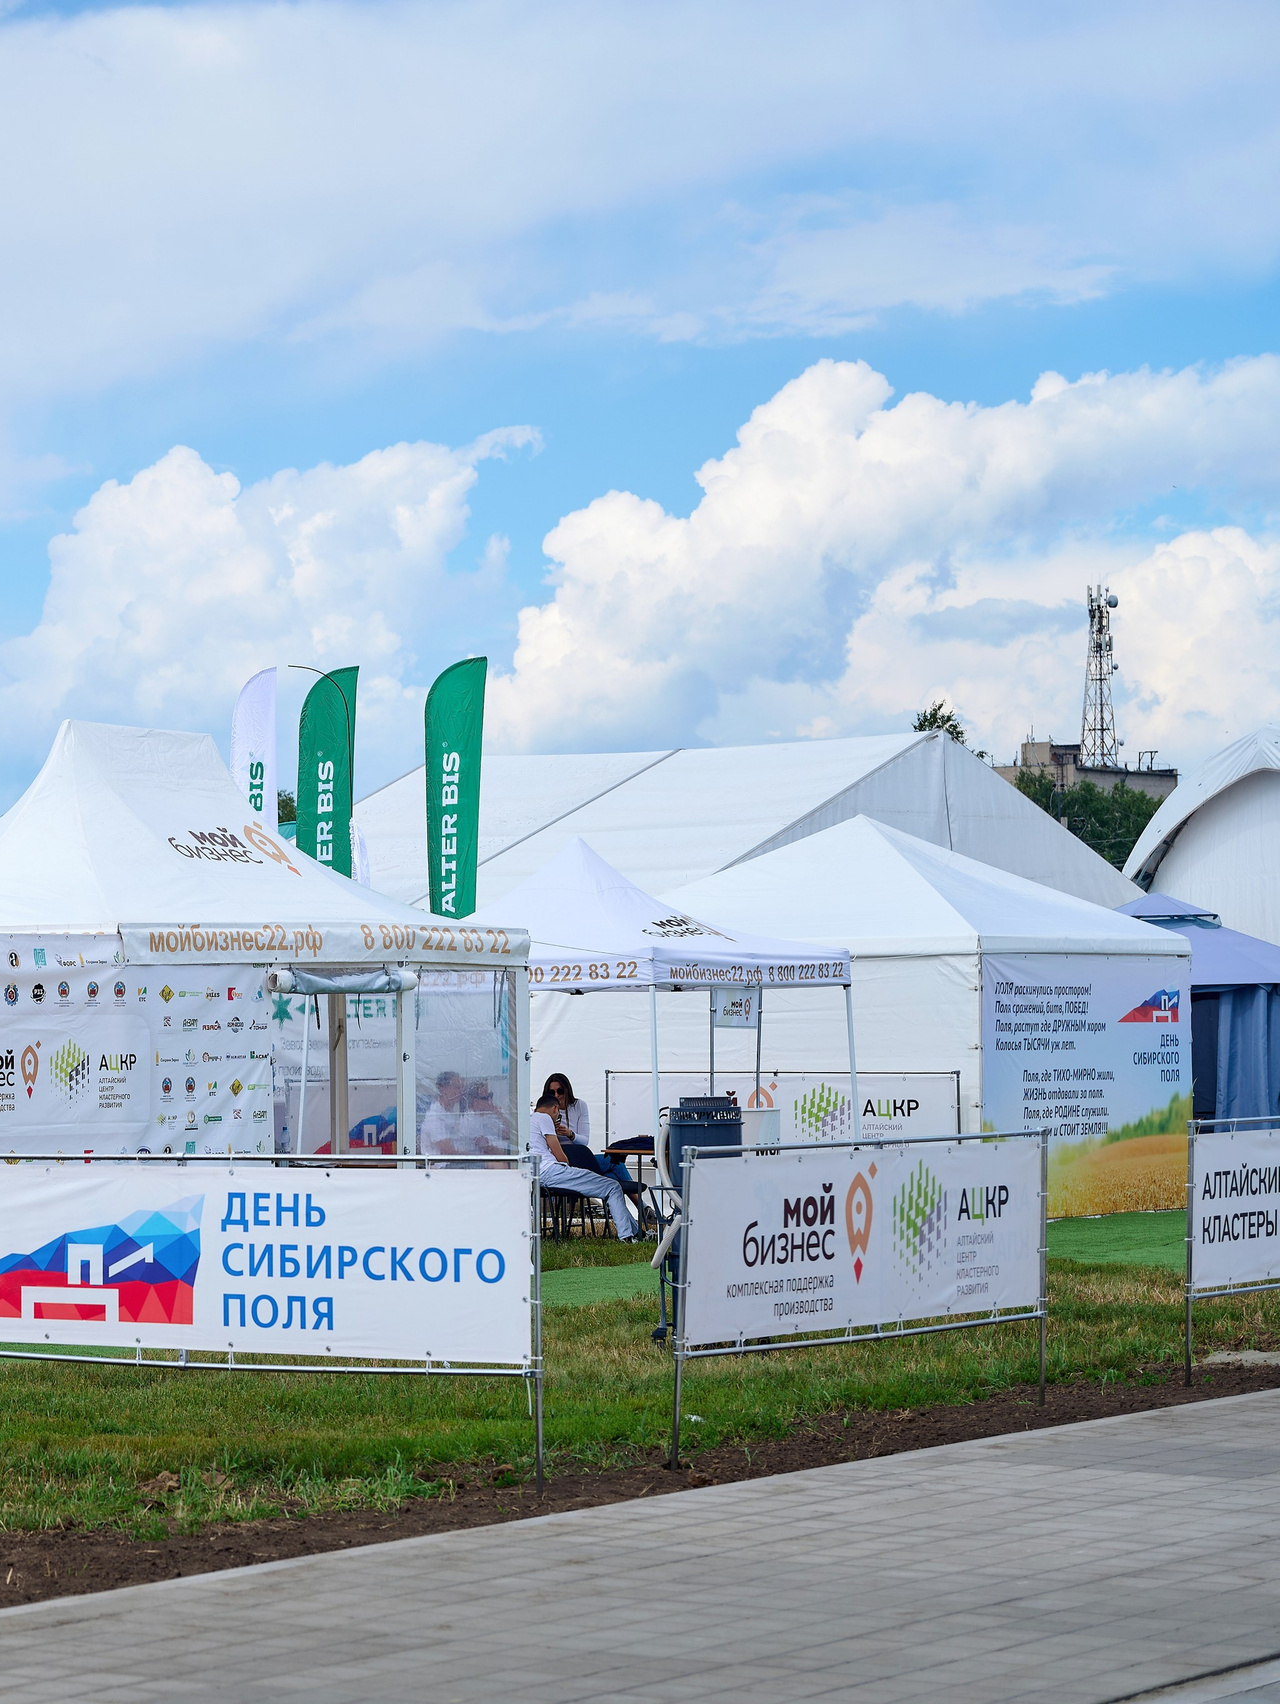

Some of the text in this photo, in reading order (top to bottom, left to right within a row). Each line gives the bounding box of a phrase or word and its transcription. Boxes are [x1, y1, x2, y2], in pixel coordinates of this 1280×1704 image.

[317, 760, 334, 815] BIS
[188, 826, 247, 849] мой
[441, 751, 460, 913] ALTER BIS
[167, 836, 264, 864] бизнес
[149, 924, 323, 957] мойбизнес22.рф
[362, 924, 511, 954] 8 800 222 83 22
[550, 961, 638, 983] 222 83 22
[670, 962, 763, 986] мойбизнес22.рф
[768, 961, 844, 982] 8 800 222 83 22
[995, 981, 1014, 995] ПОЛЯ
[723, 1006, 743, 1017] бизнес
[731, 998, 743, 1009] мой
[995, 1001, 1012, 1013] Поля
[1064, 1001, 1089, 1015] ПОБЕД!
[1040, 1020, 1051, 1032] где
[1052, 1019, 1086, 1034] ДРУЖНЫМ
[1086, 1022, 1106, 1034] хором
[1023, 1038, 1050, 1051] ТЫСЯЧИ
[1160, 1034, 1180, 1049] ДЕНЬ
[99, 1054, 137, 1074] АЦКР
[1133, 1051, 1180, 1065] СИБИРСКОГО
[98, 1075, 127, 1084] АЛТАЙСКИЙ
[1040, 1069, 1052, 1083] где
[1052, 1068, 1096, 1082] ТИХО-МИРНО
[1160, 1069, 1180, 1082] ПОЛЯ
[98, 1085, 114, 1093] ЦЕНТР
[1022, 1087, 1047, 1101] ЖИЗНЬ
[98, 1101, 123, 1109] РАЗВИТИЯ
[862, 1099, 920, 1120] АЦКР
[1041, 1106, 1053, 1119] где
[1054, 1105, 1081, 1120] РОДИНЕ
[862, 1123, 903, 1131] АЛТАЙСКИЙ
[1059, 1123, 1080, 1137] СТОИТ
[1202, 1162, 1280, 1200] АЛТАЙСКИ
[221, 1192, 326, 1234] ДЕНЬ
[783, 1183, 835, 1229] мой
[958, 1185, 1009, 1226] АЦКР
[1202, 1209, 1278, 1245] КЛАСТЕРЫ
[742, 1220, 835, 1268] бизнес
[956, 1232, 994, 1247] АЛТАЙСКИЙ
[221, 1241, 506, 1284] СИБИРСКОГО
[956, 1251, 977, 1265] ЦЕНТР
[956, 1265, 1000, 1280] КЛАСТЕРНОГО
[726, 1273, 834, 1299] комплексная поддержка
[956, 1282, 989, 1297] РАЗВИТИЯ
[222, 1293, 334, 1331] ПОЛЯ
[773, 1297, 834, 1318] производства
